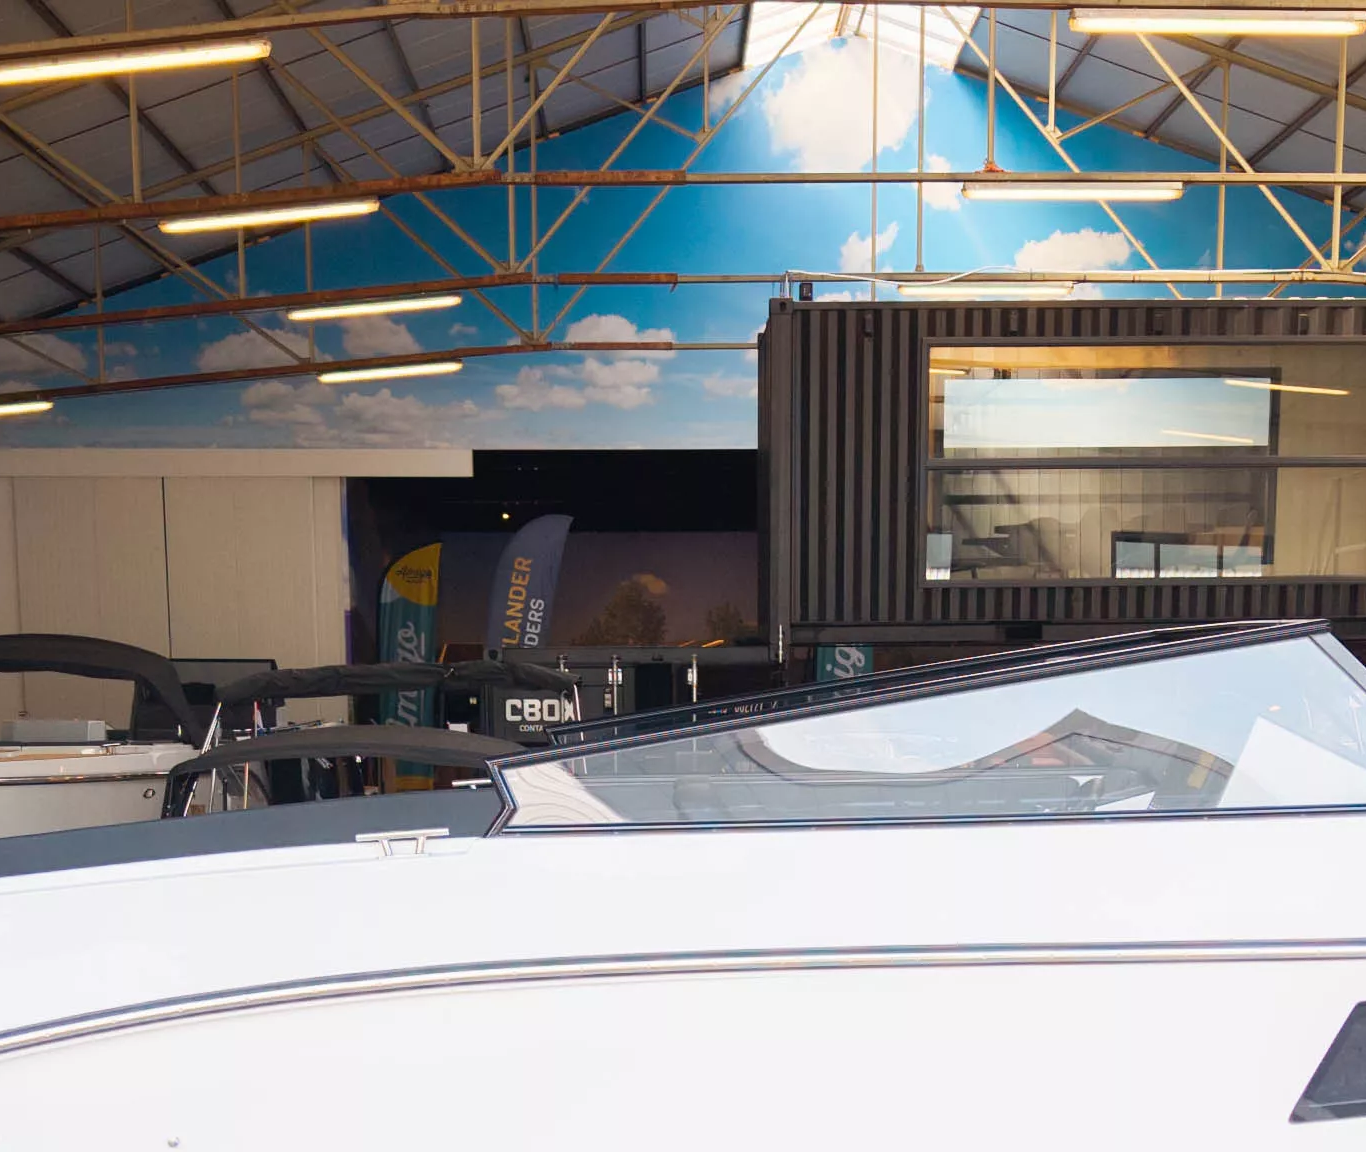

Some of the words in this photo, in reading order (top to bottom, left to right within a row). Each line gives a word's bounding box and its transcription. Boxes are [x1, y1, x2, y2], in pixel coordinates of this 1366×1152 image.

[501, 557, 533, 648] LANDER
[523, 598, 545, 649] DERS
[505, 699, 575, 722] CBOX
